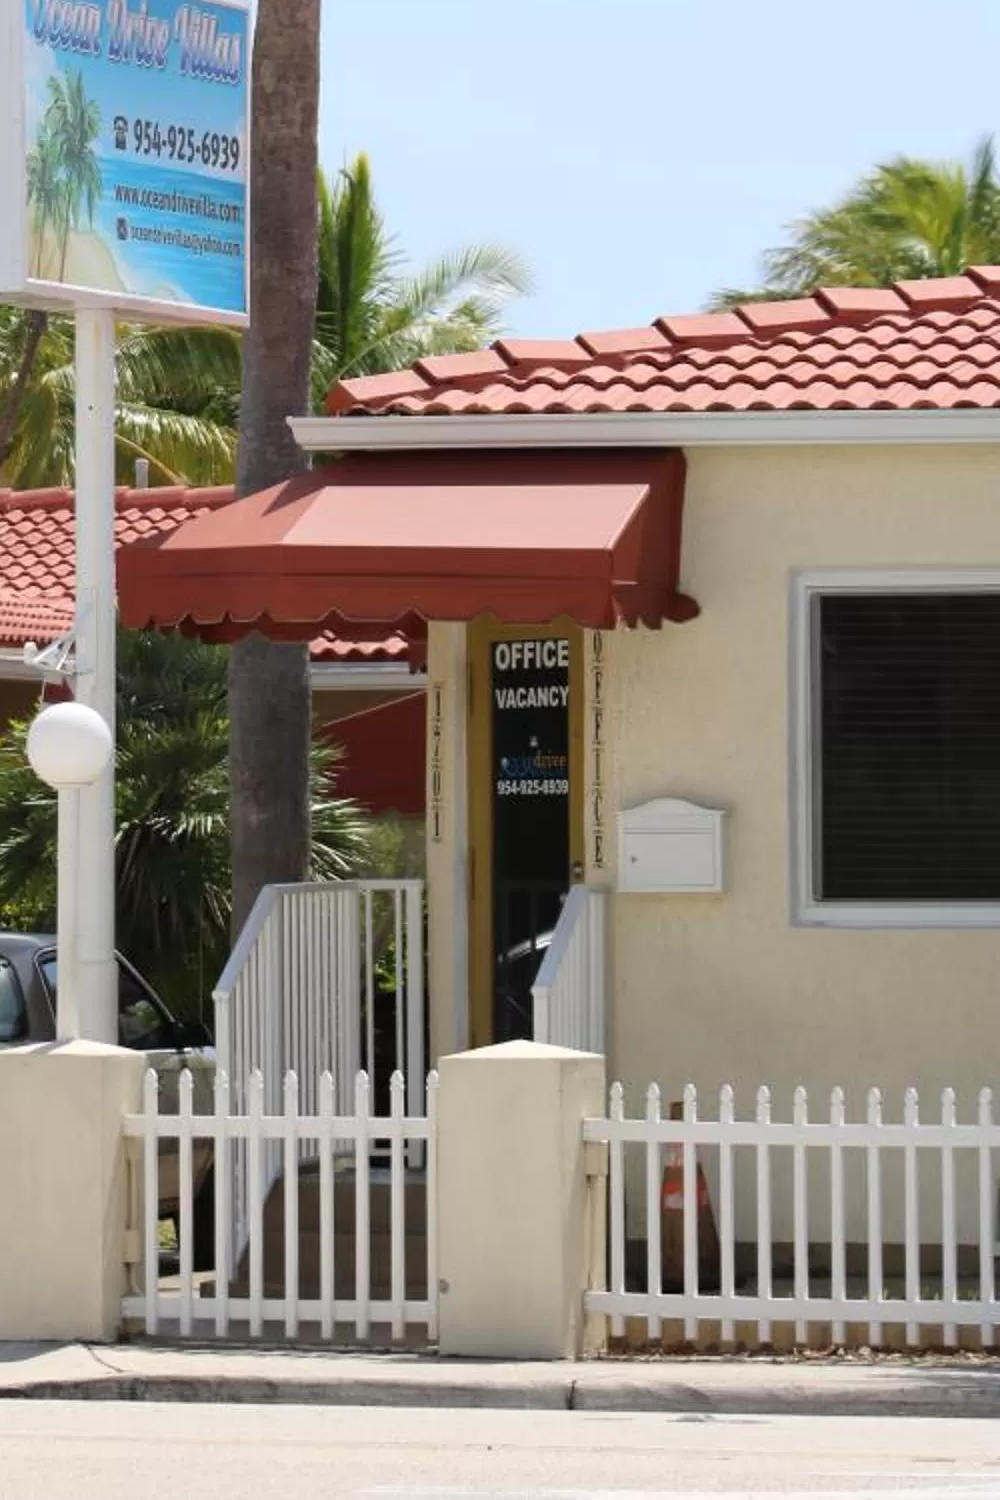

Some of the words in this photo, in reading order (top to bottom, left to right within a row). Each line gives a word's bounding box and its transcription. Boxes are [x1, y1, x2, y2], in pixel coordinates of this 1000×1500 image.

[173, 3, 242, 87] Villas
[133, 118, 240, 171] 954-925-6939
[495, 640, 569, 671] OFFICE
[496, 685, 569, 709] VACANCY
